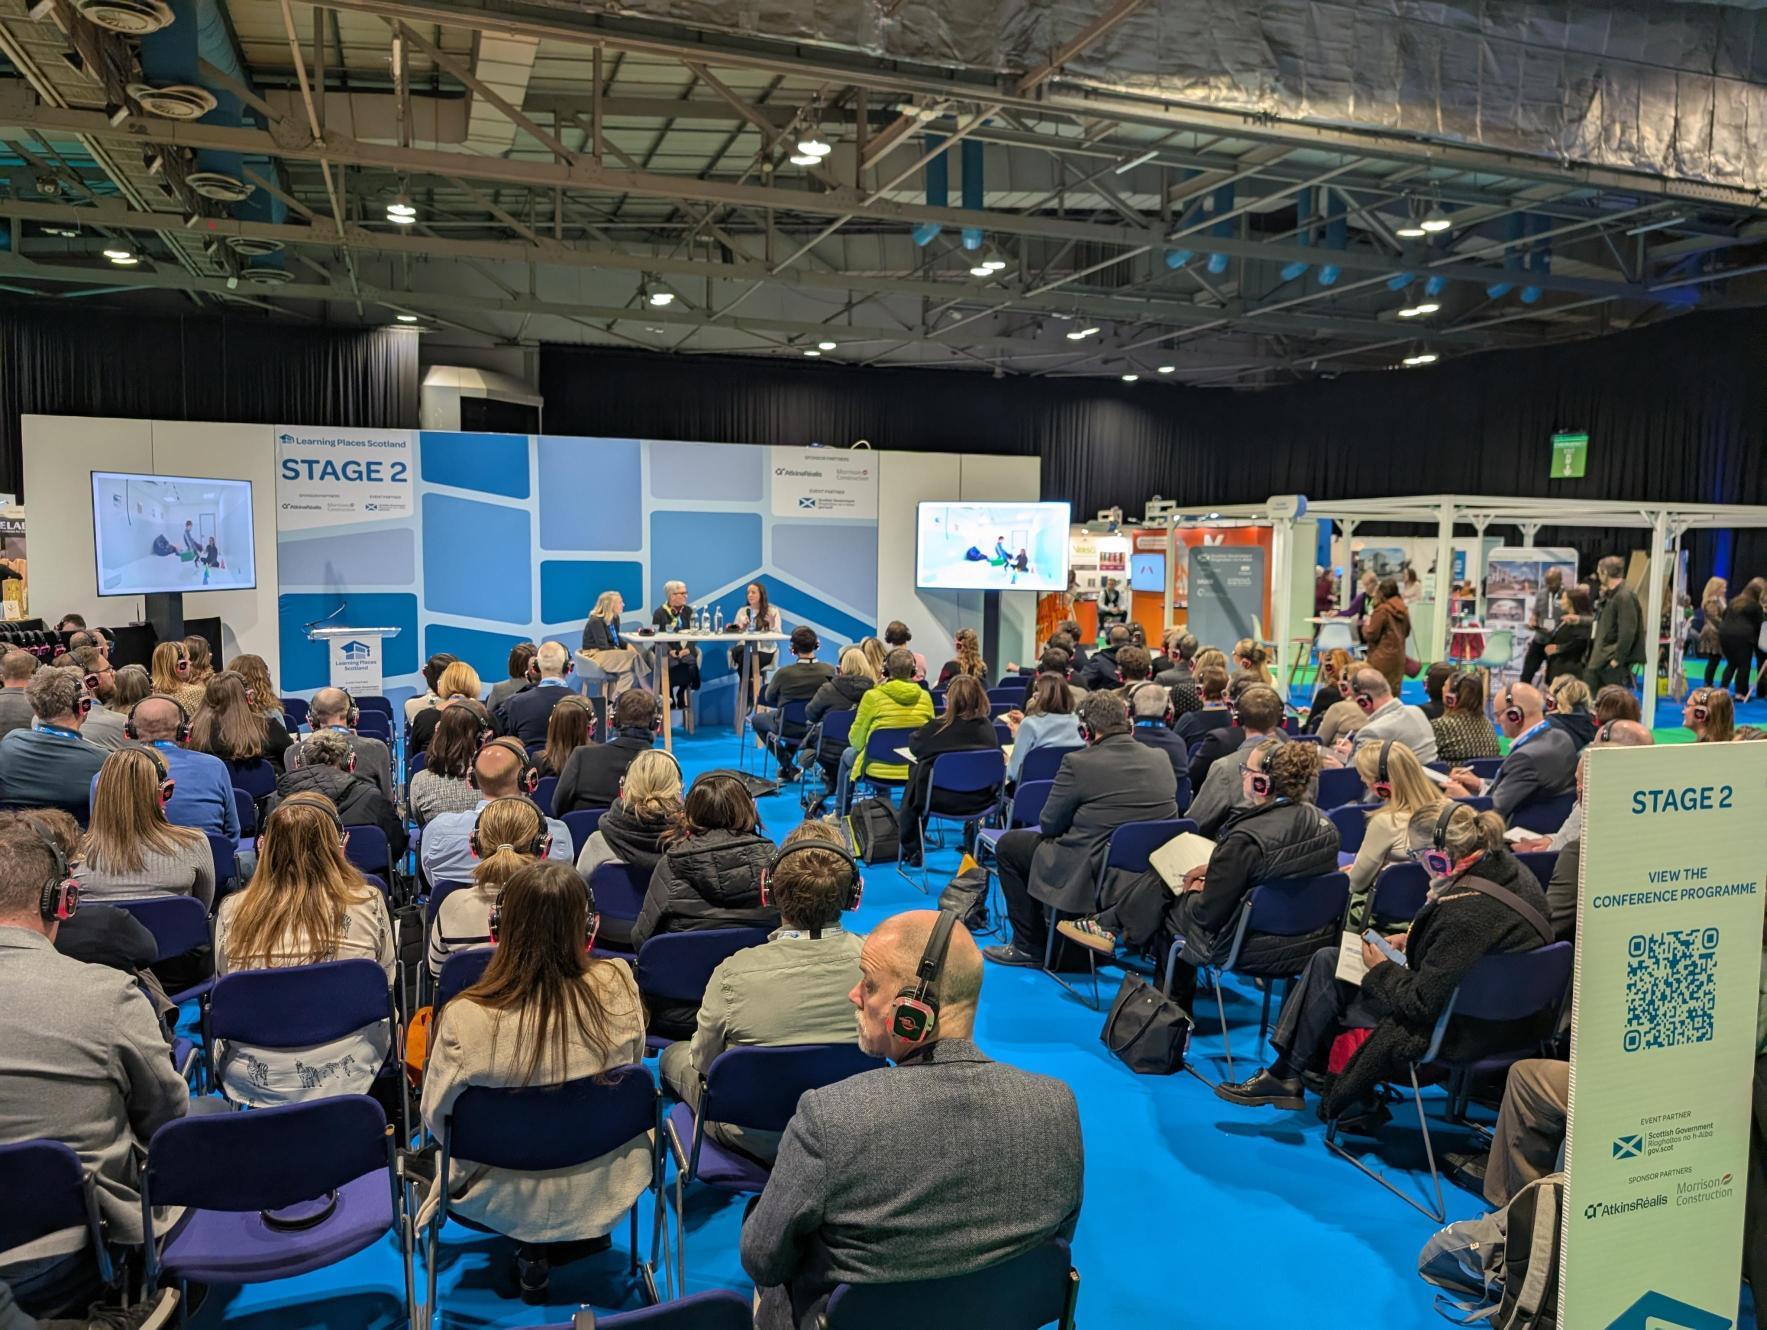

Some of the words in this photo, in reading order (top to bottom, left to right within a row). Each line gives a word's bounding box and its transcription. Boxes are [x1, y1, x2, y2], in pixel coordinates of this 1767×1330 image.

[296, 437, 336, 448] Learning
[337, 438, 366, 447] Places
[367, 440, 406, 448] Scotland
[282, 458, 384, 482] STAGE
[390, 461, 408, 482] 2
[1631, 786, 1714, 815] STAGE
[1719, 785, 1733, 808] 2
[1648, 869, 1681, 884] VIEW
[1683, 867, 1708, 880] THE
[1593, 889, 1678, 909] CONFERENCE
[1681, 882, 1757, 901] PROGRAMME
[1640, 1115, 1662, 1126] EVENT
[1662, 1110, 1692, 1121] PARTNER
[1648, 1129, 1674, 1139] Scottish
[1675, 1122, 1714, 1135] Government
[1647, 1144, 1674, 1156] gov.scot
[1628, 1172, 1659, 1185] SPONSOR
[1659, 1166, 1693, 1180] PARTNERS
[1676, 1177, 1720, 1195] Morrison
[1601, 1194, 1668, 1217] AtkinsRéalis
[1676, 1187, 1733, 1207] Construction
